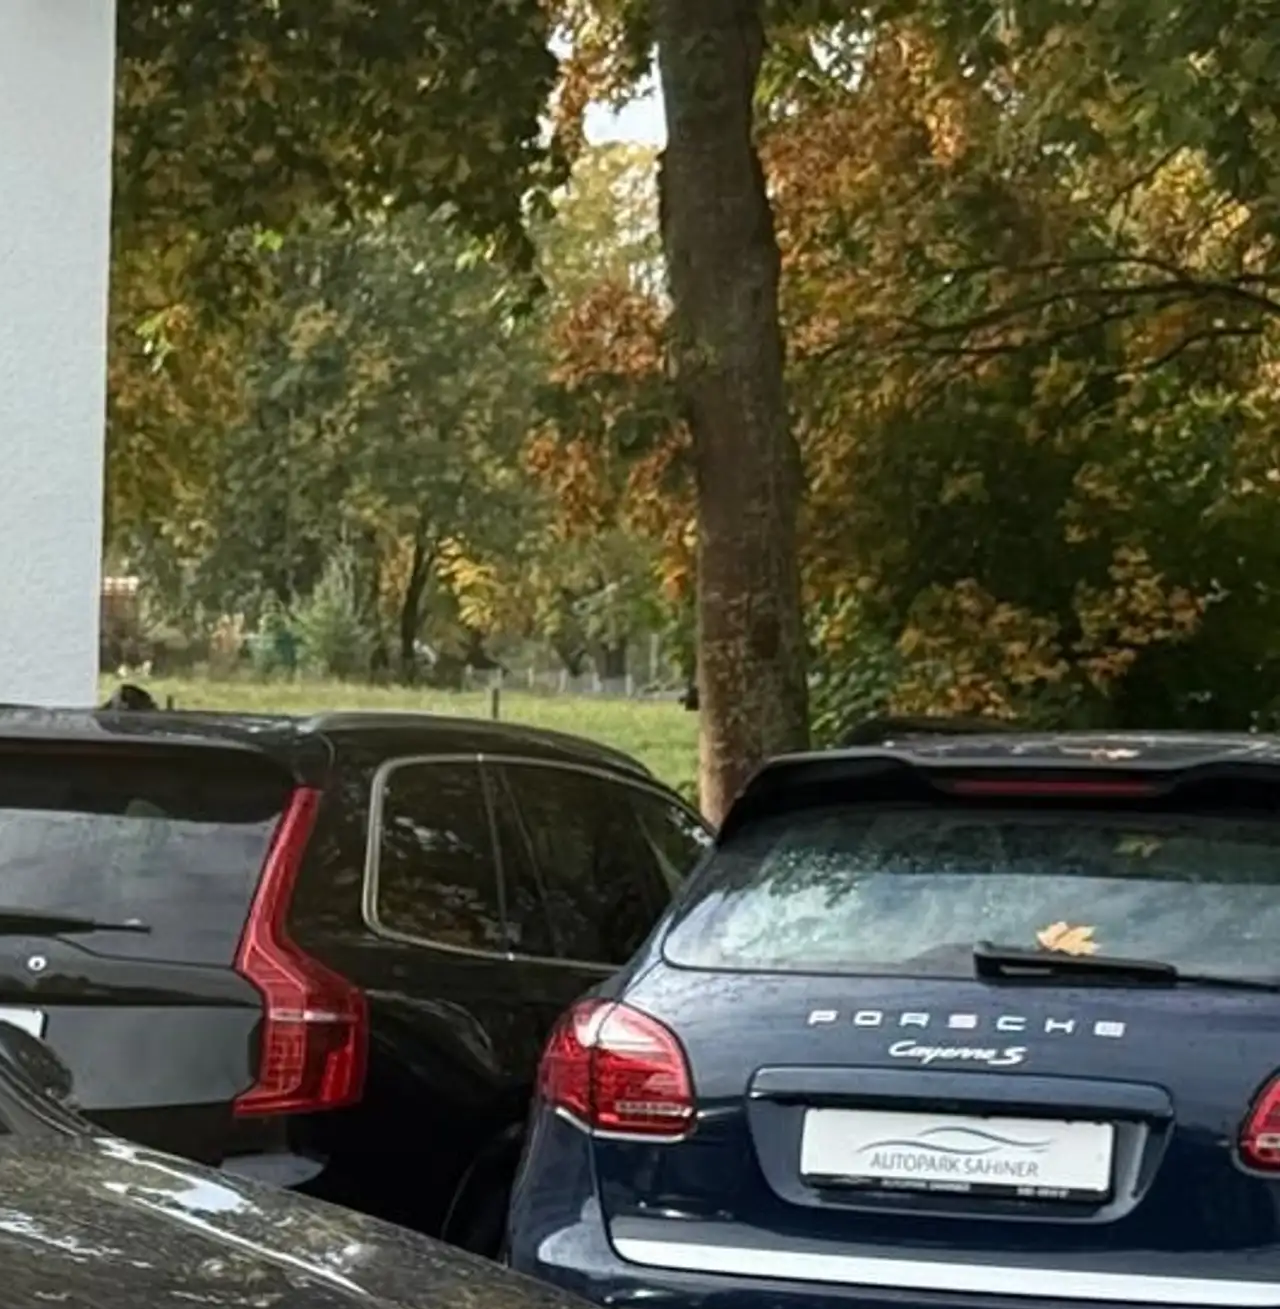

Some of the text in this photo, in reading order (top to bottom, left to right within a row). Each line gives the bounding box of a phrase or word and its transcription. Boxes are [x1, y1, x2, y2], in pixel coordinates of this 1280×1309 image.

[807, 1009, 1126, 1039] PORSCHE
[888, 1040, 1028, 1066] Cayenne S
[870, 1152, 1040, 1178] AUTOPARK SAHINER
